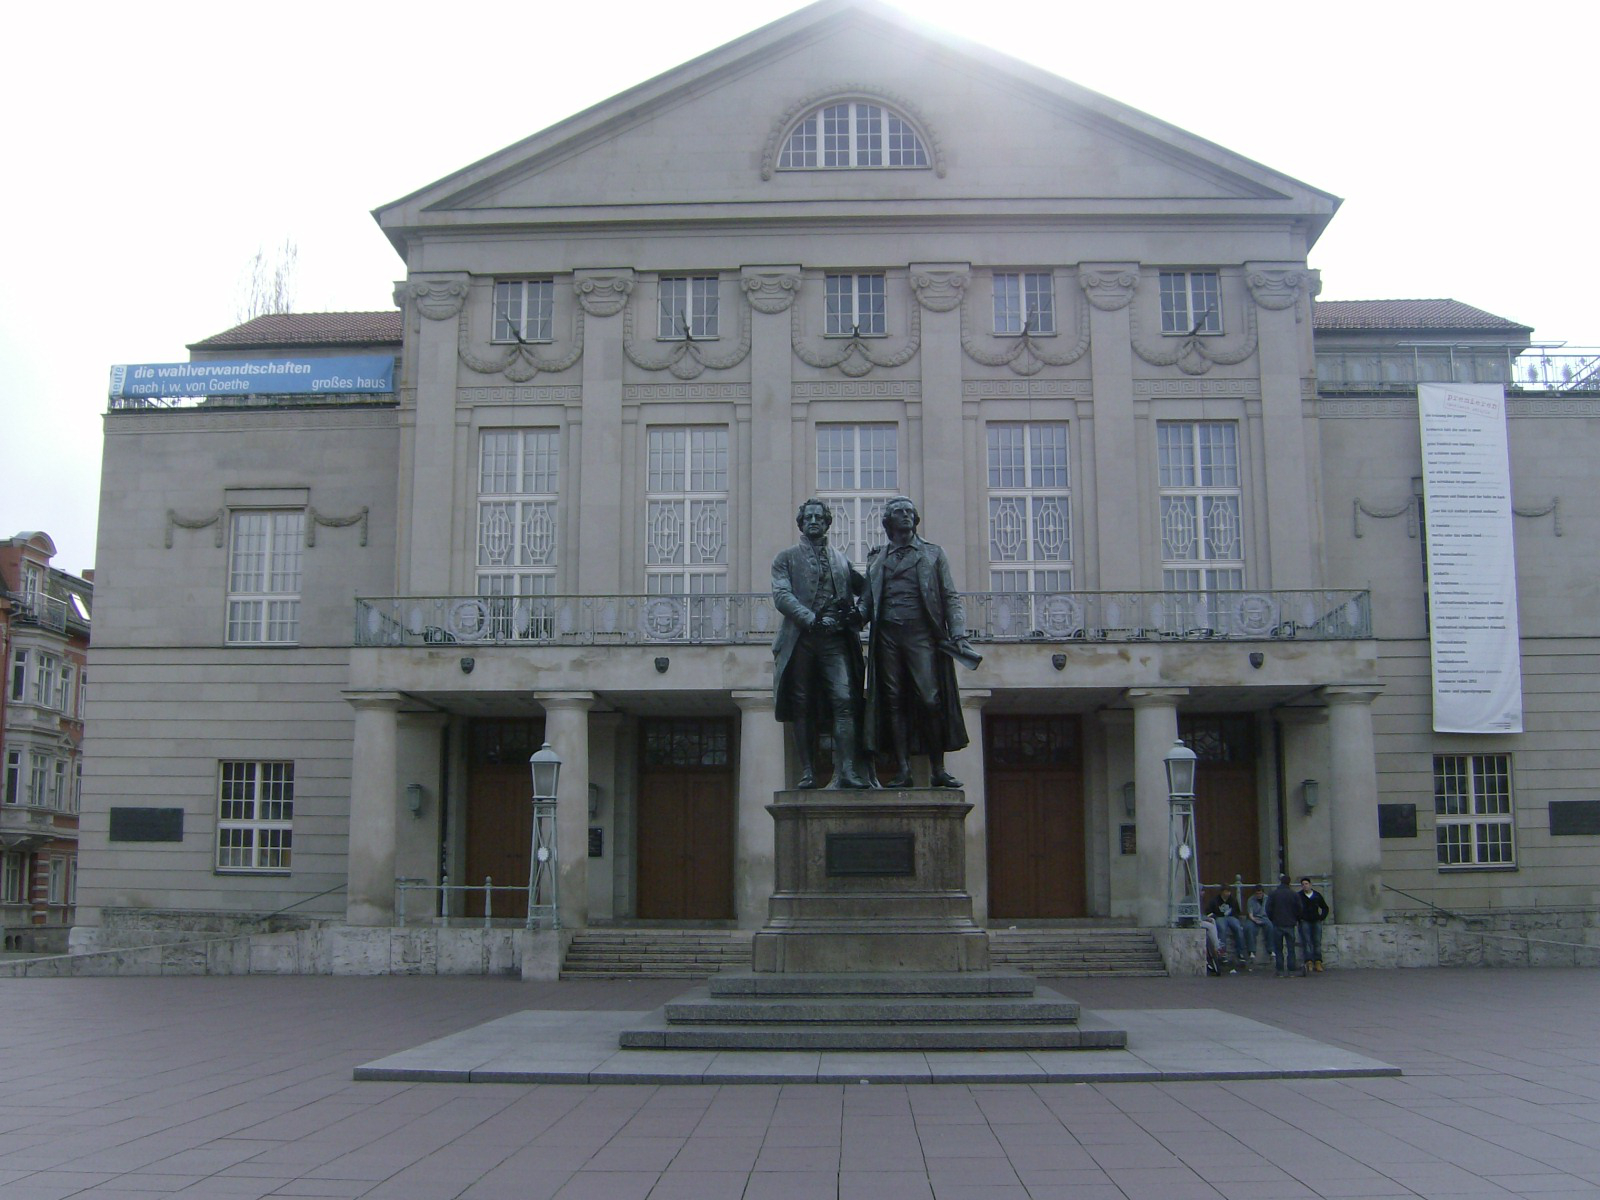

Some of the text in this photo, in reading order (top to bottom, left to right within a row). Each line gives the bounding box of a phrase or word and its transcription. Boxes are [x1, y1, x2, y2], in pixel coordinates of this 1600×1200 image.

[134, 361, 311, 379] die wahlverwandtschaften
[132, 378, 250, 395] nach j. w. von Goethe
[311, 375, 386, 391] großes haus
